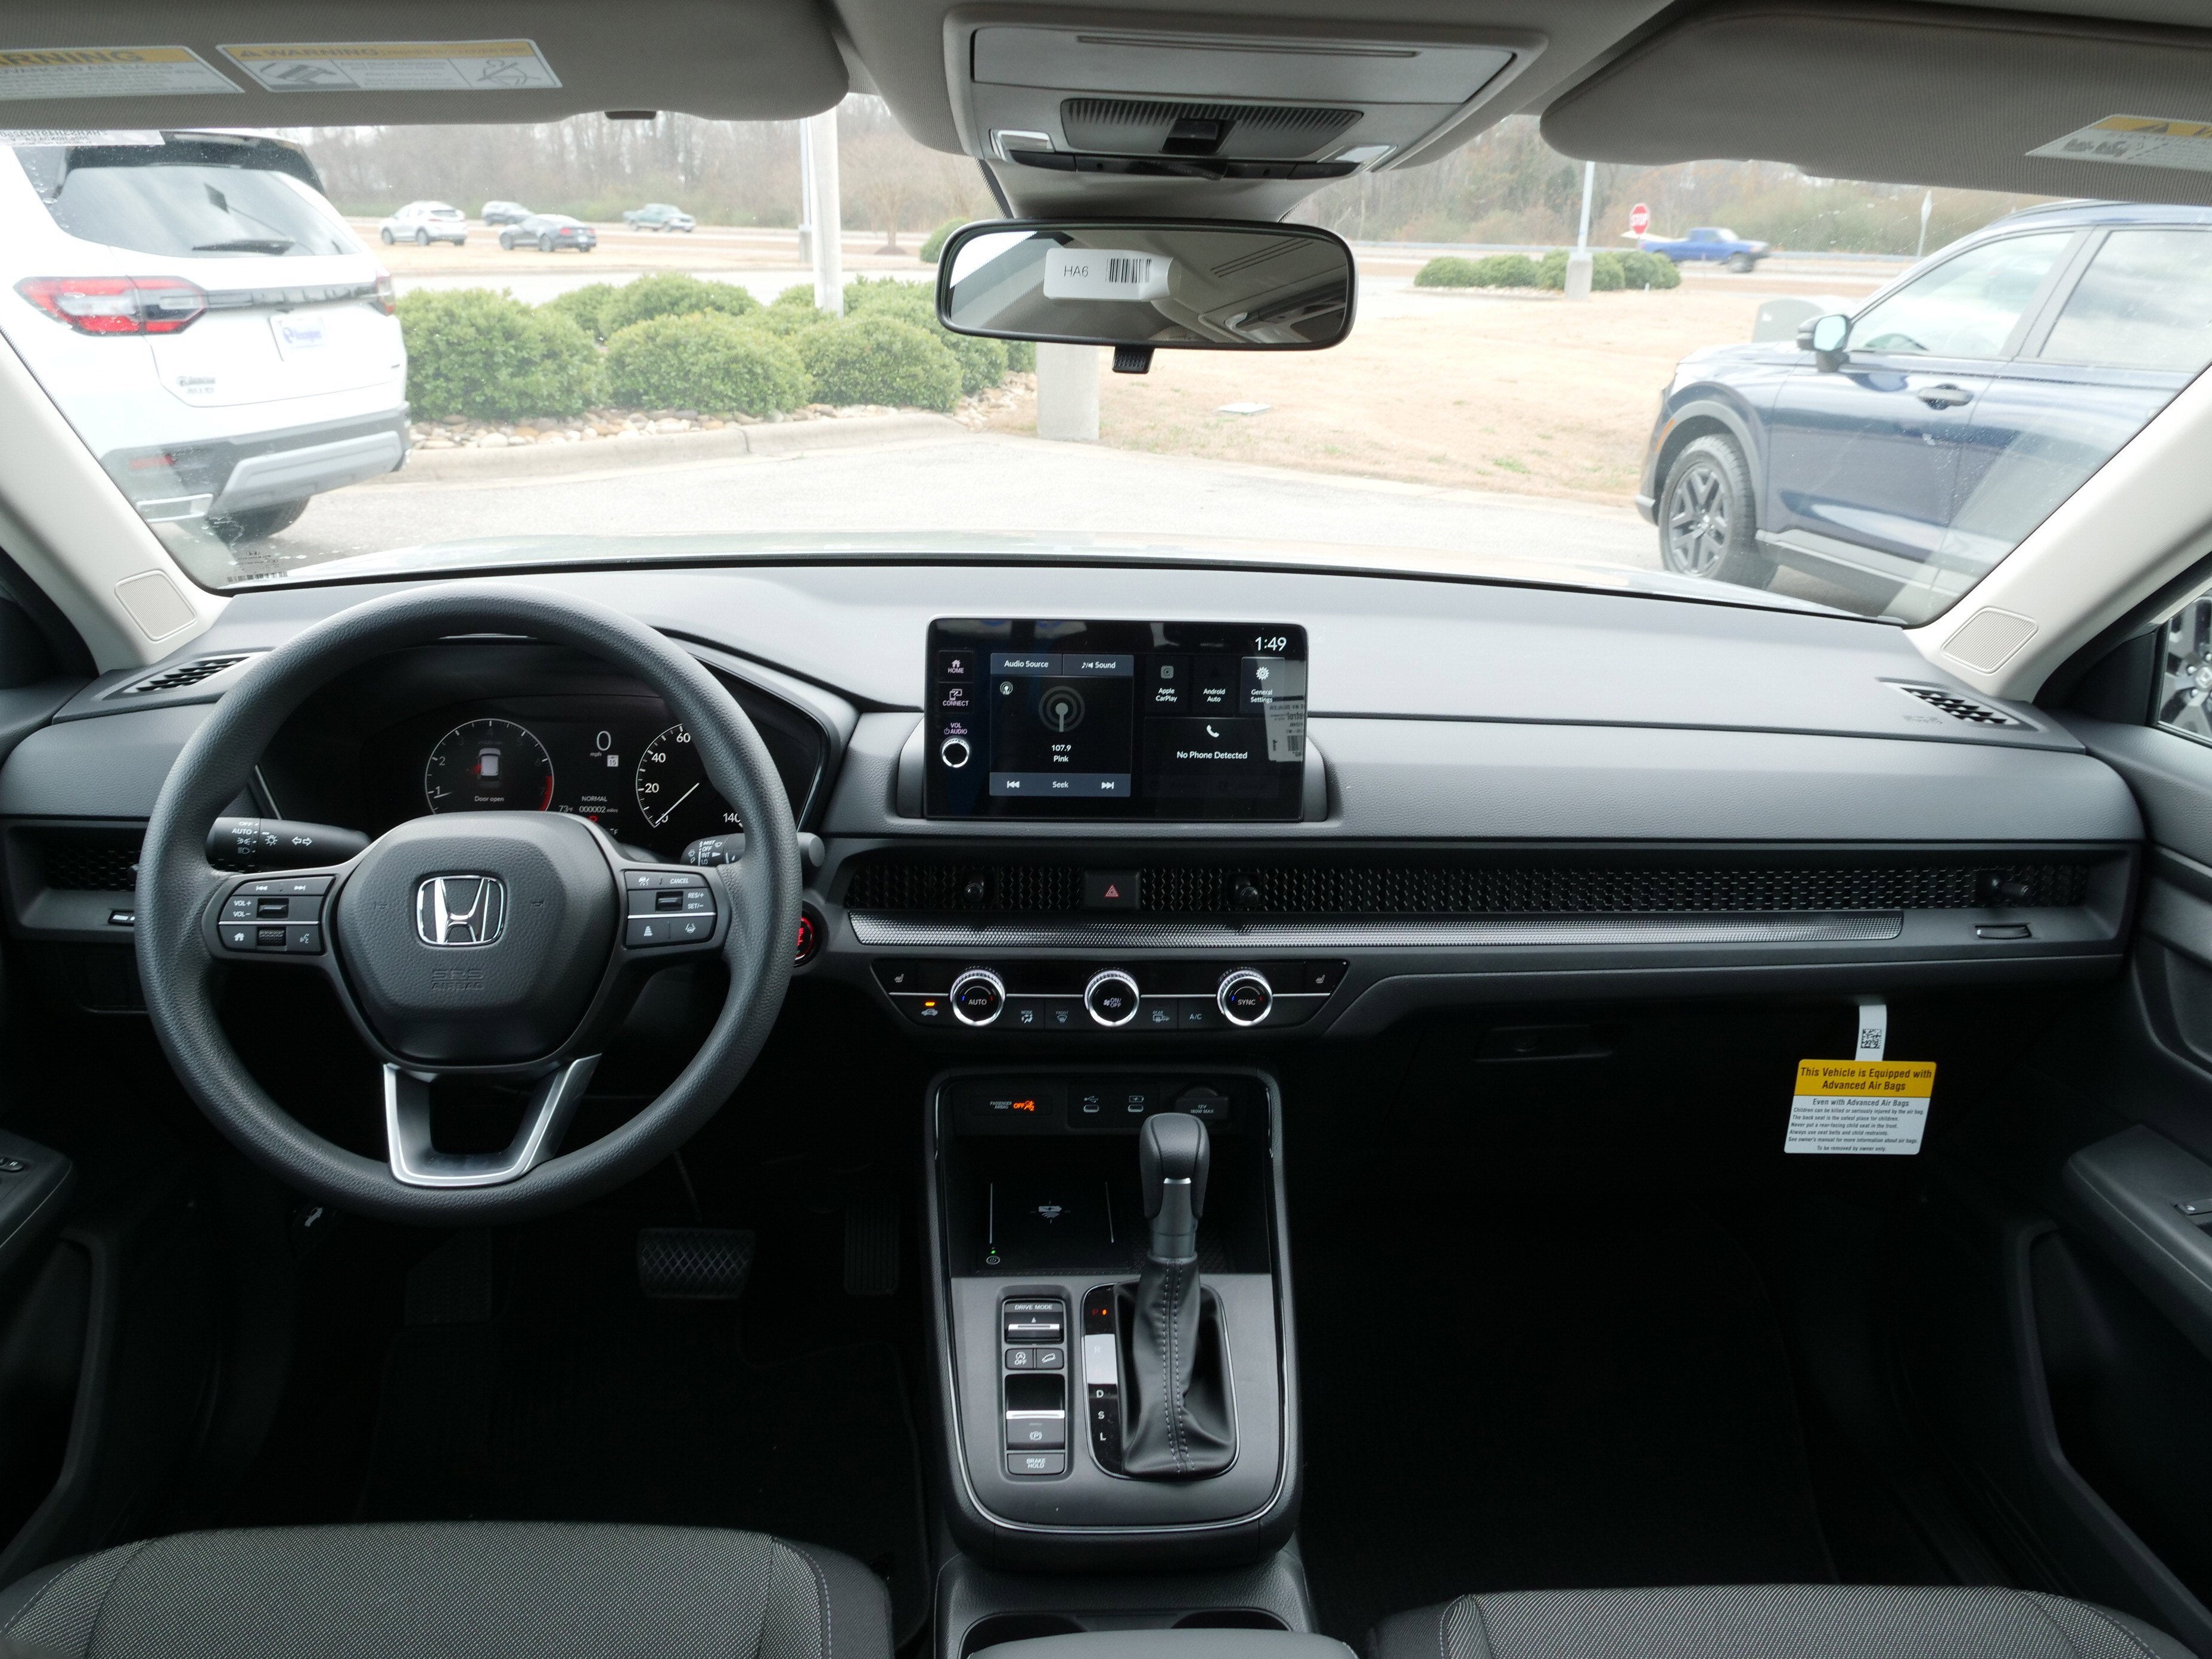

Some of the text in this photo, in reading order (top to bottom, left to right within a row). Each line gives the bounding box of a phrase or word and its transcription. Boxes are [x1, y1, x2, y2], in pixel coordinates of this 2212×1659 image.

[1064, 266, 1089, 277] HA6
[1254, 636, 1287, 651] 1:49
[597, 731, 611, 751] 0
[676, 732, 691, 742] 60
[439, 756, 446, 766] 2
[651, 753, 666, 763] 40
[435, 786, 440, 795] 1
[645, 783, 659, 793] 20
[1800, 1067, 1932, 1080] This Vehicle is Equipped with
[1822, 1080, 1906, 1092] Advanced Air Bags
[1893, 1099, 1910, 1108] Bags
[1096, 1390, 1104, 1398] D
[1098, 1411, 1105, 1419] S
[1099, 1432, 1107, 1441] L
